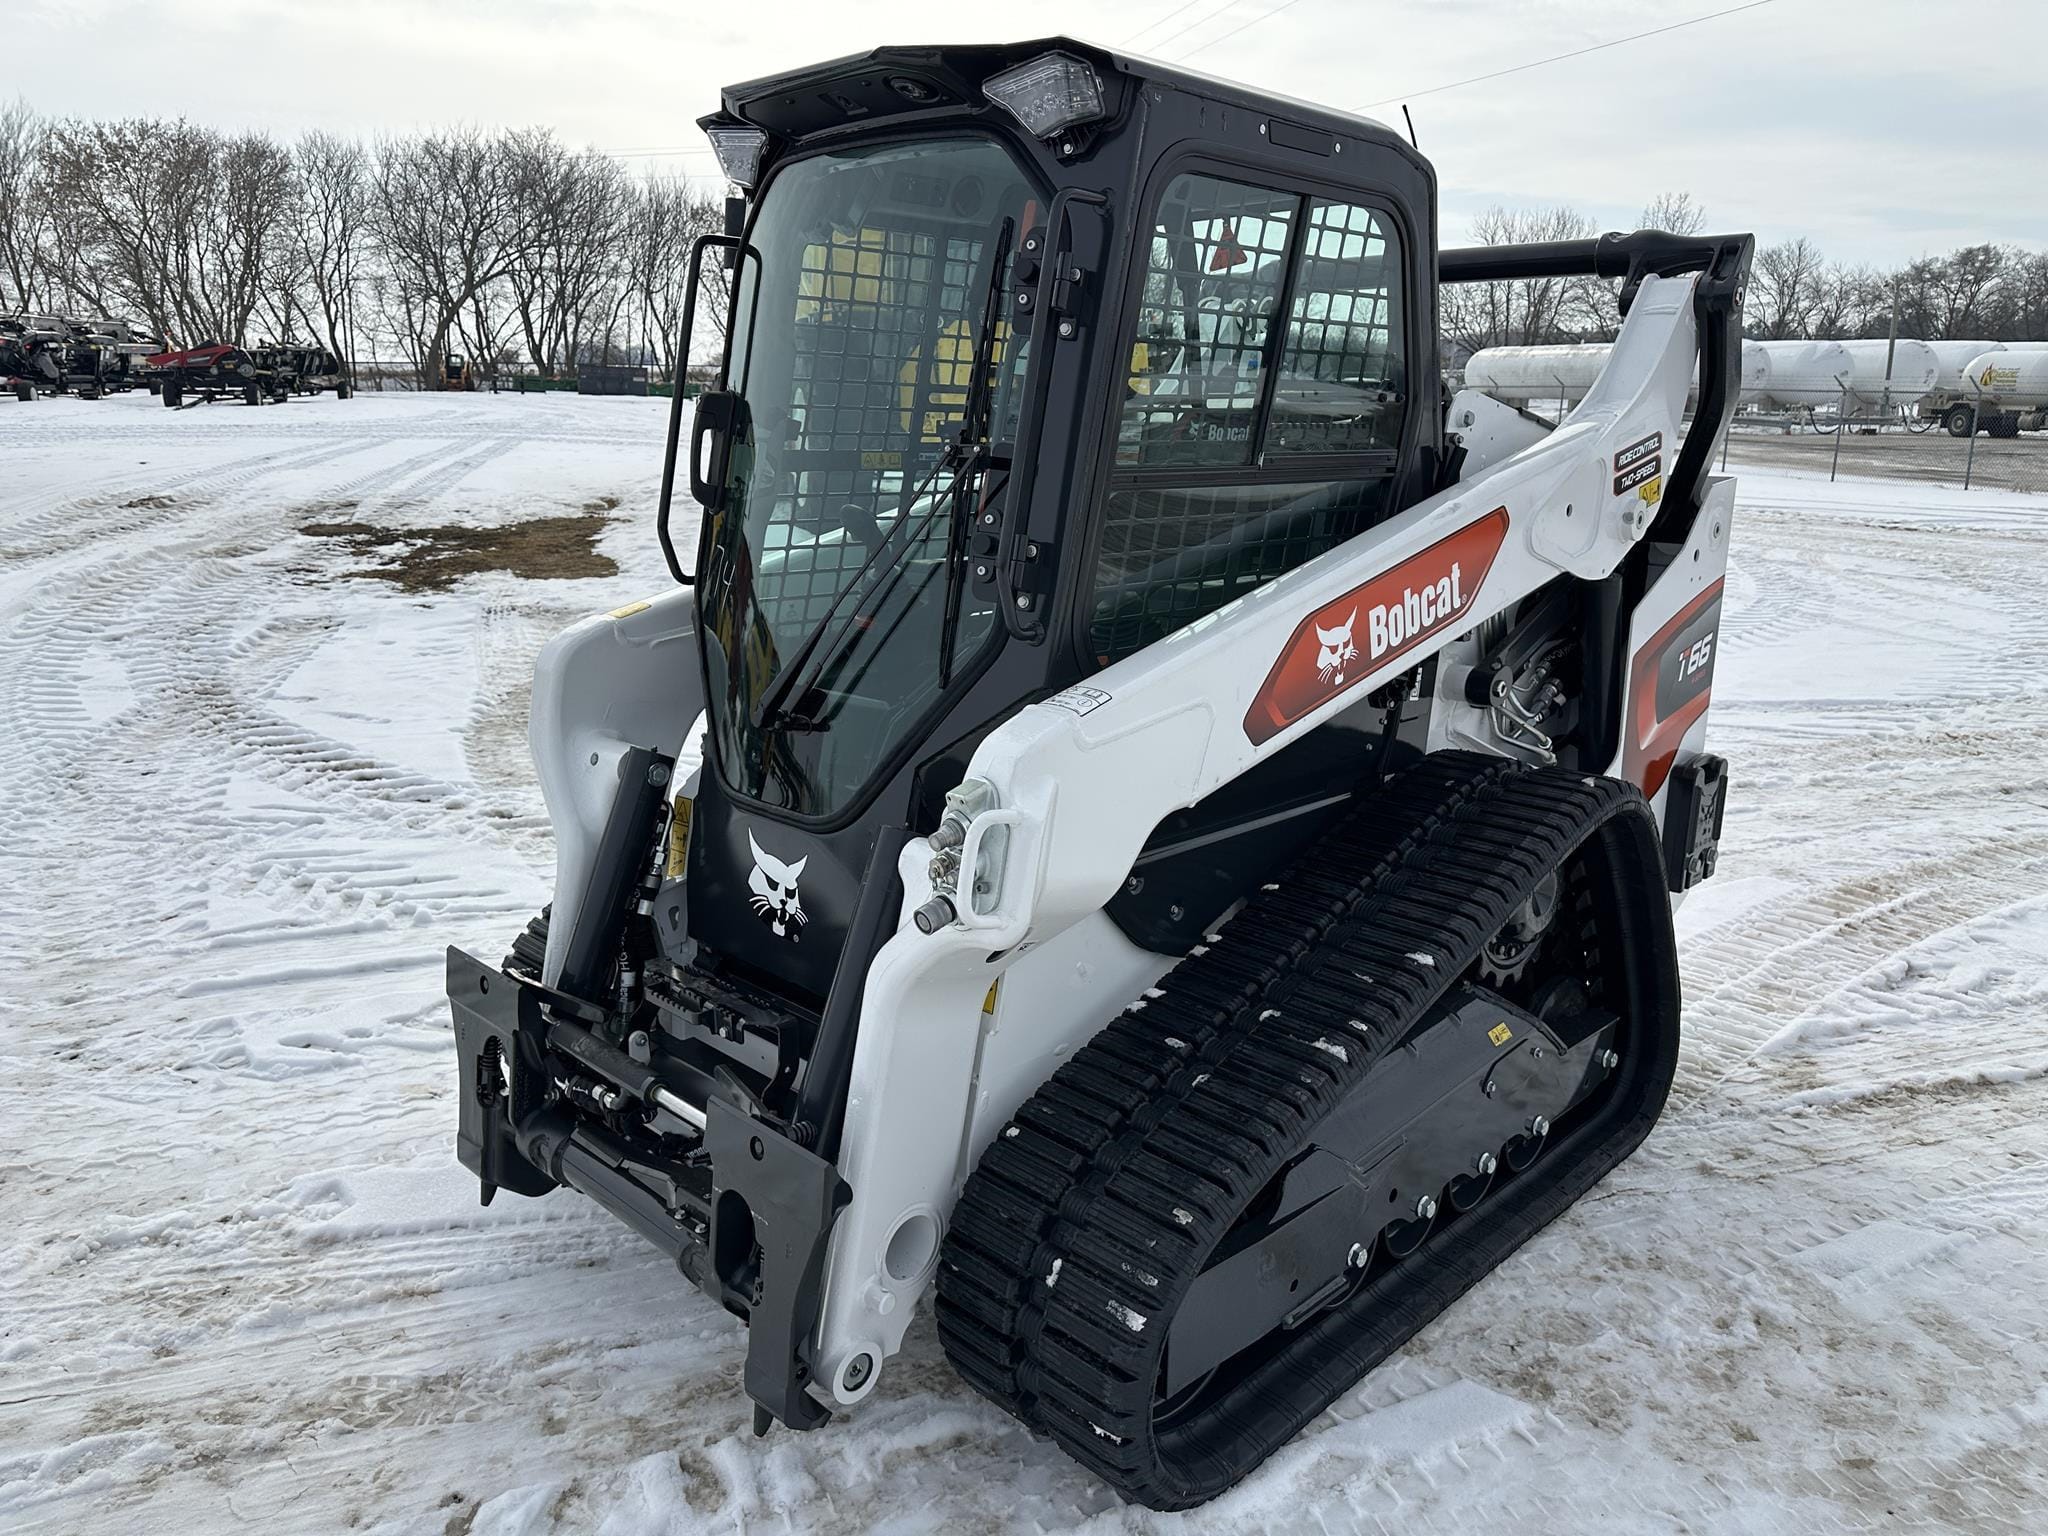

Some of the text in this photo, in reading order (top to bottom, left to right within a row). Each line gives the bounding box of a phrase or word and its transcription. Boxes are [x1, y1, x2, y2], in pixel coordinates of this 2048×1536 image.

[1621, 461, 1656, 489] TWO-SPEED
[1368, 562, 1461, 660] Bobcat
[1678, 631, 1714, 682] T66
